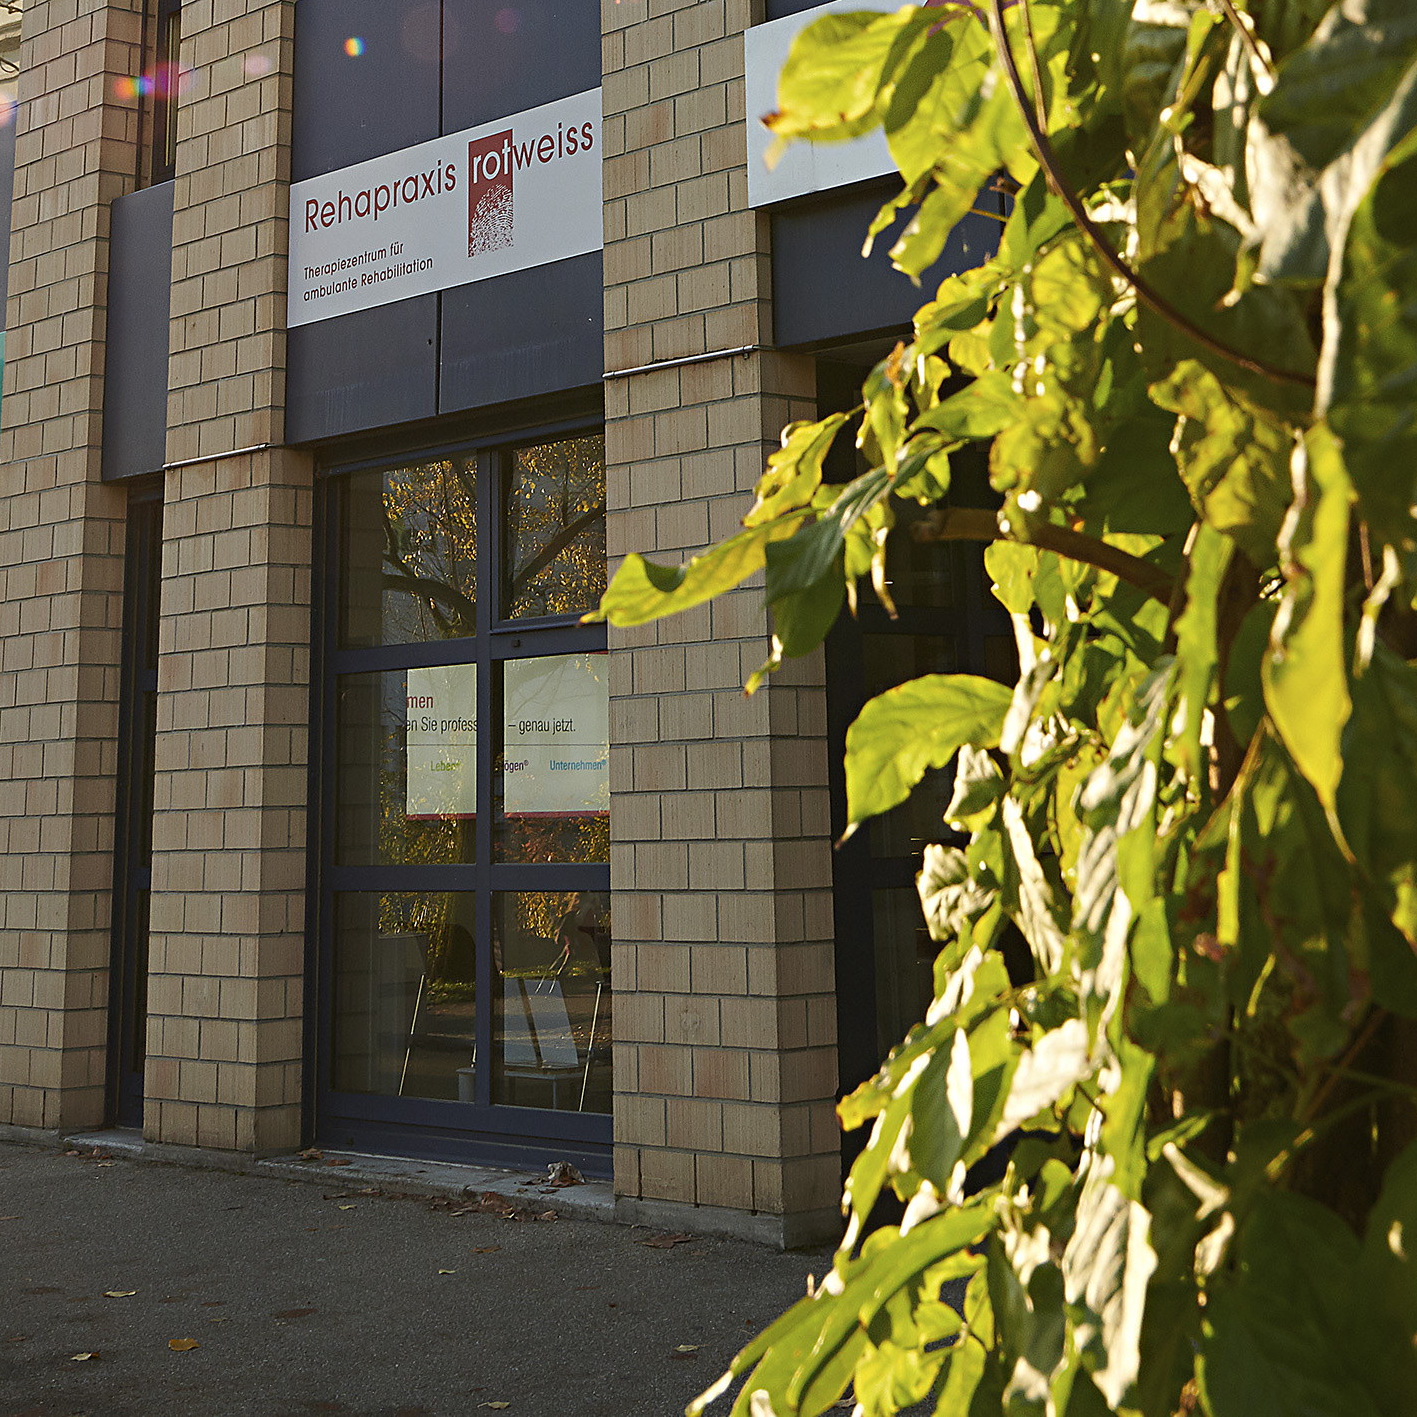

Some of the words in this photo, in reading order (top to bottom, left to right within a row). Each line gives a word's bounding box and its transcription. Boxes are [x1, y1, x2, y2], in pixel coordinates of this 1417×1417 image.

[304, 159, 457, 234] Rehapraxis
[471, 120, 594, 185] rotweiss
[303, 245, 387, 281] Therapiezentrum
[389, 241, 405, 258] für
[303, 275, 358, 303] ambulante
[360, 255, 433, 287] Rehabilitation
[421, 716, 438, 732] Sie
[440, 716, 478, 735] profess
[518, 719, 550, 735] genau
[552, 718, 576, 735] jetzt.
